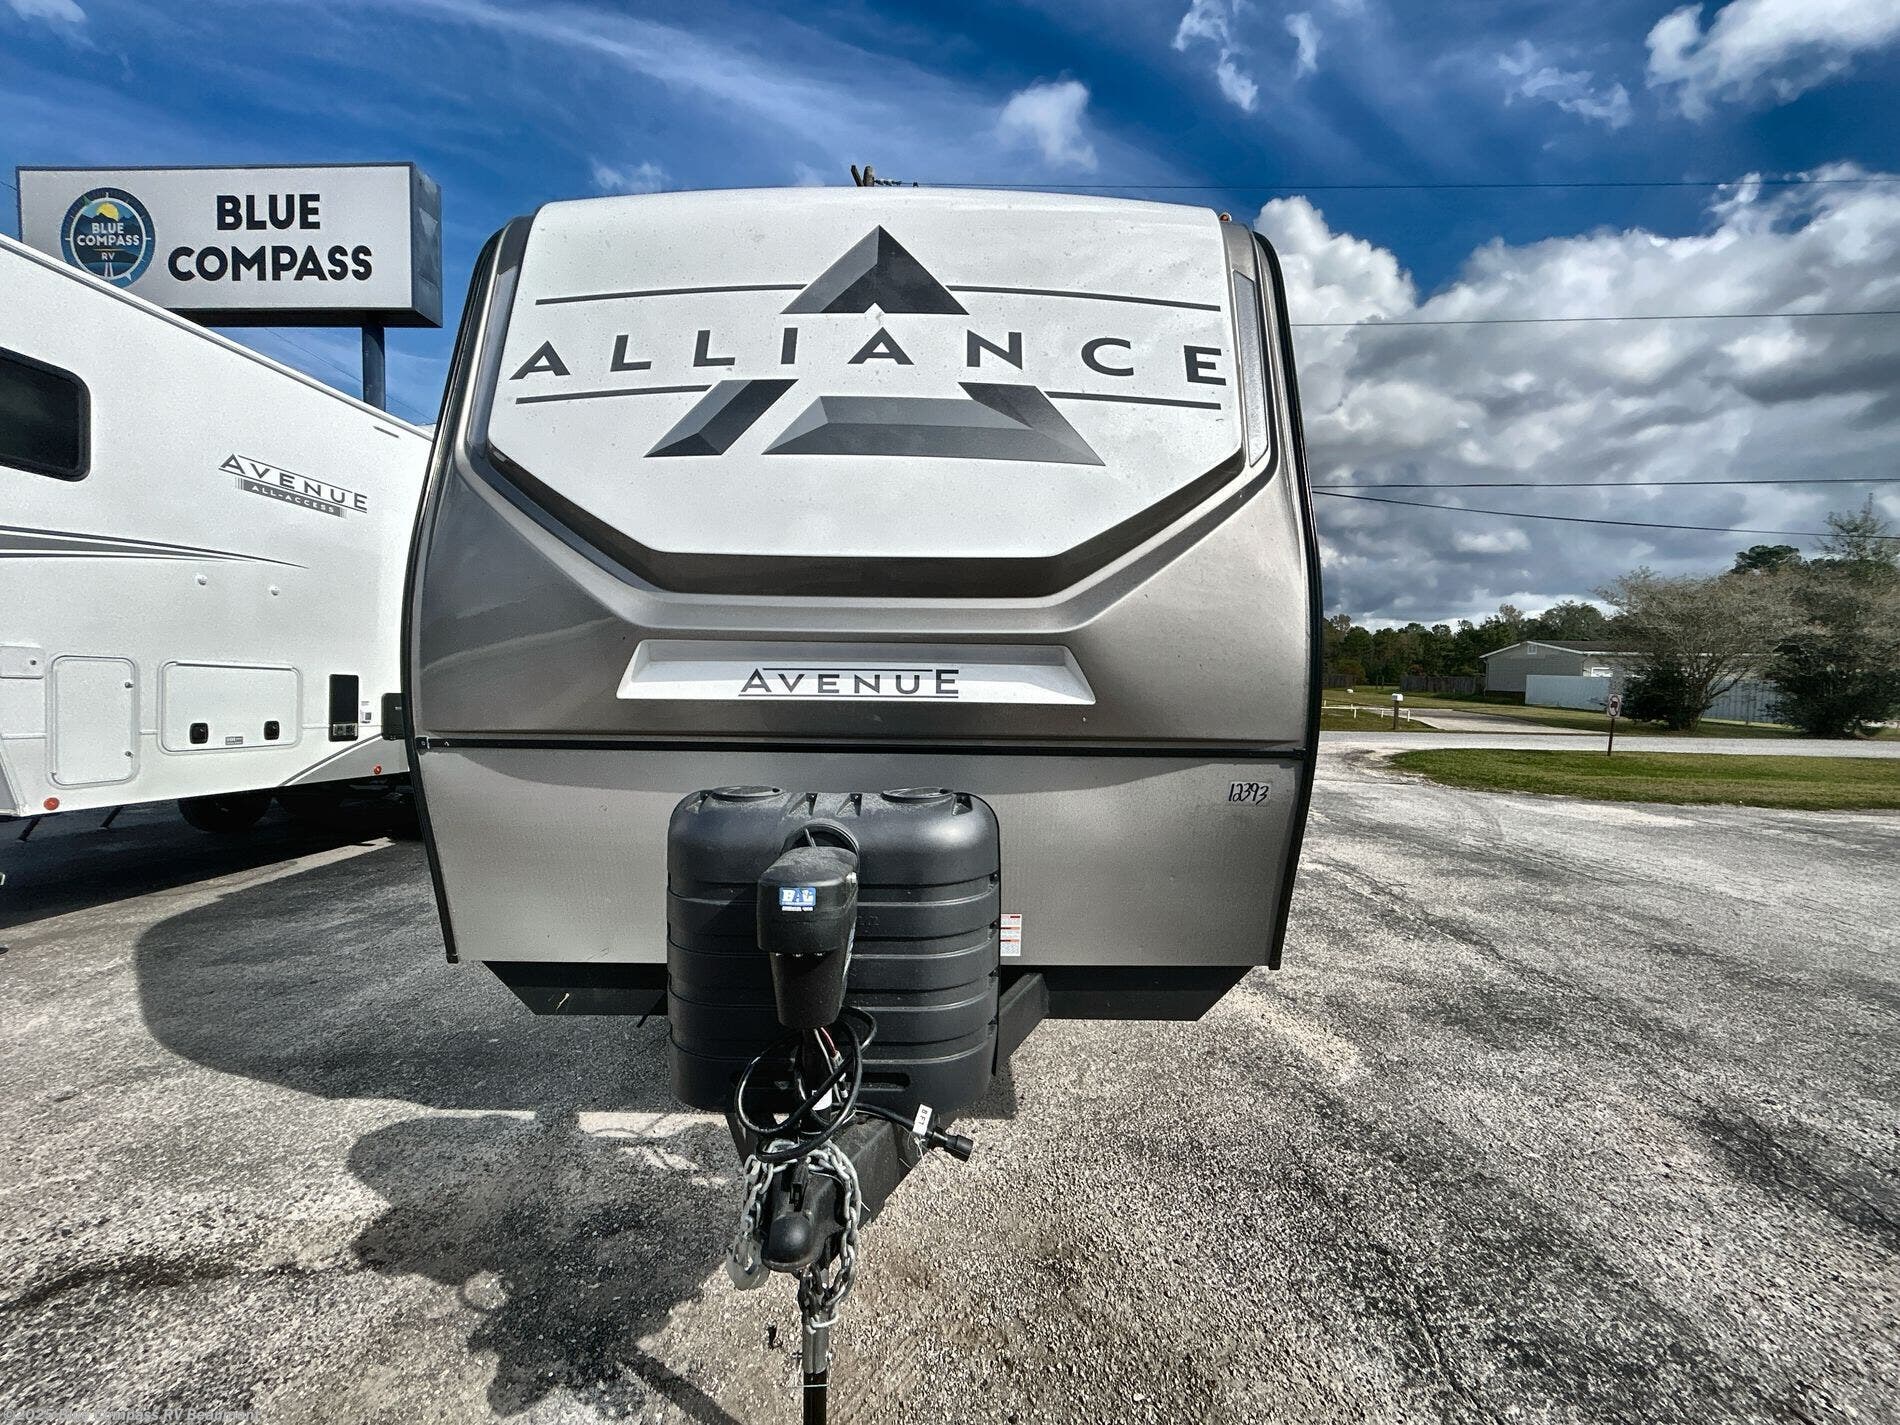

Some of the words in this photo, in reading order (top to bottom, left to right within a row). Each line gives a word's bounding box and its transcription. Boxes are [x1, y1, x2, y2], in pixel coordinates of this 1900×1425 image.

[217, 194, 320, 230] BLUE
[76, 235, 140, 246] COMPASS
[91, 222, 125, 234] BLUE
[101, 252, 115, 260] RV
[168, 245, 372, 281] COMPASS
[509, 327, 1228, 386] ALLIANCE
[220, 453, 368, 511] AVENUE
[251, 485, 335, 513] ALL-ACCESS
[740, 668, 959, 694] AVENUE
[1229, 782, 1269, 805] 12393
